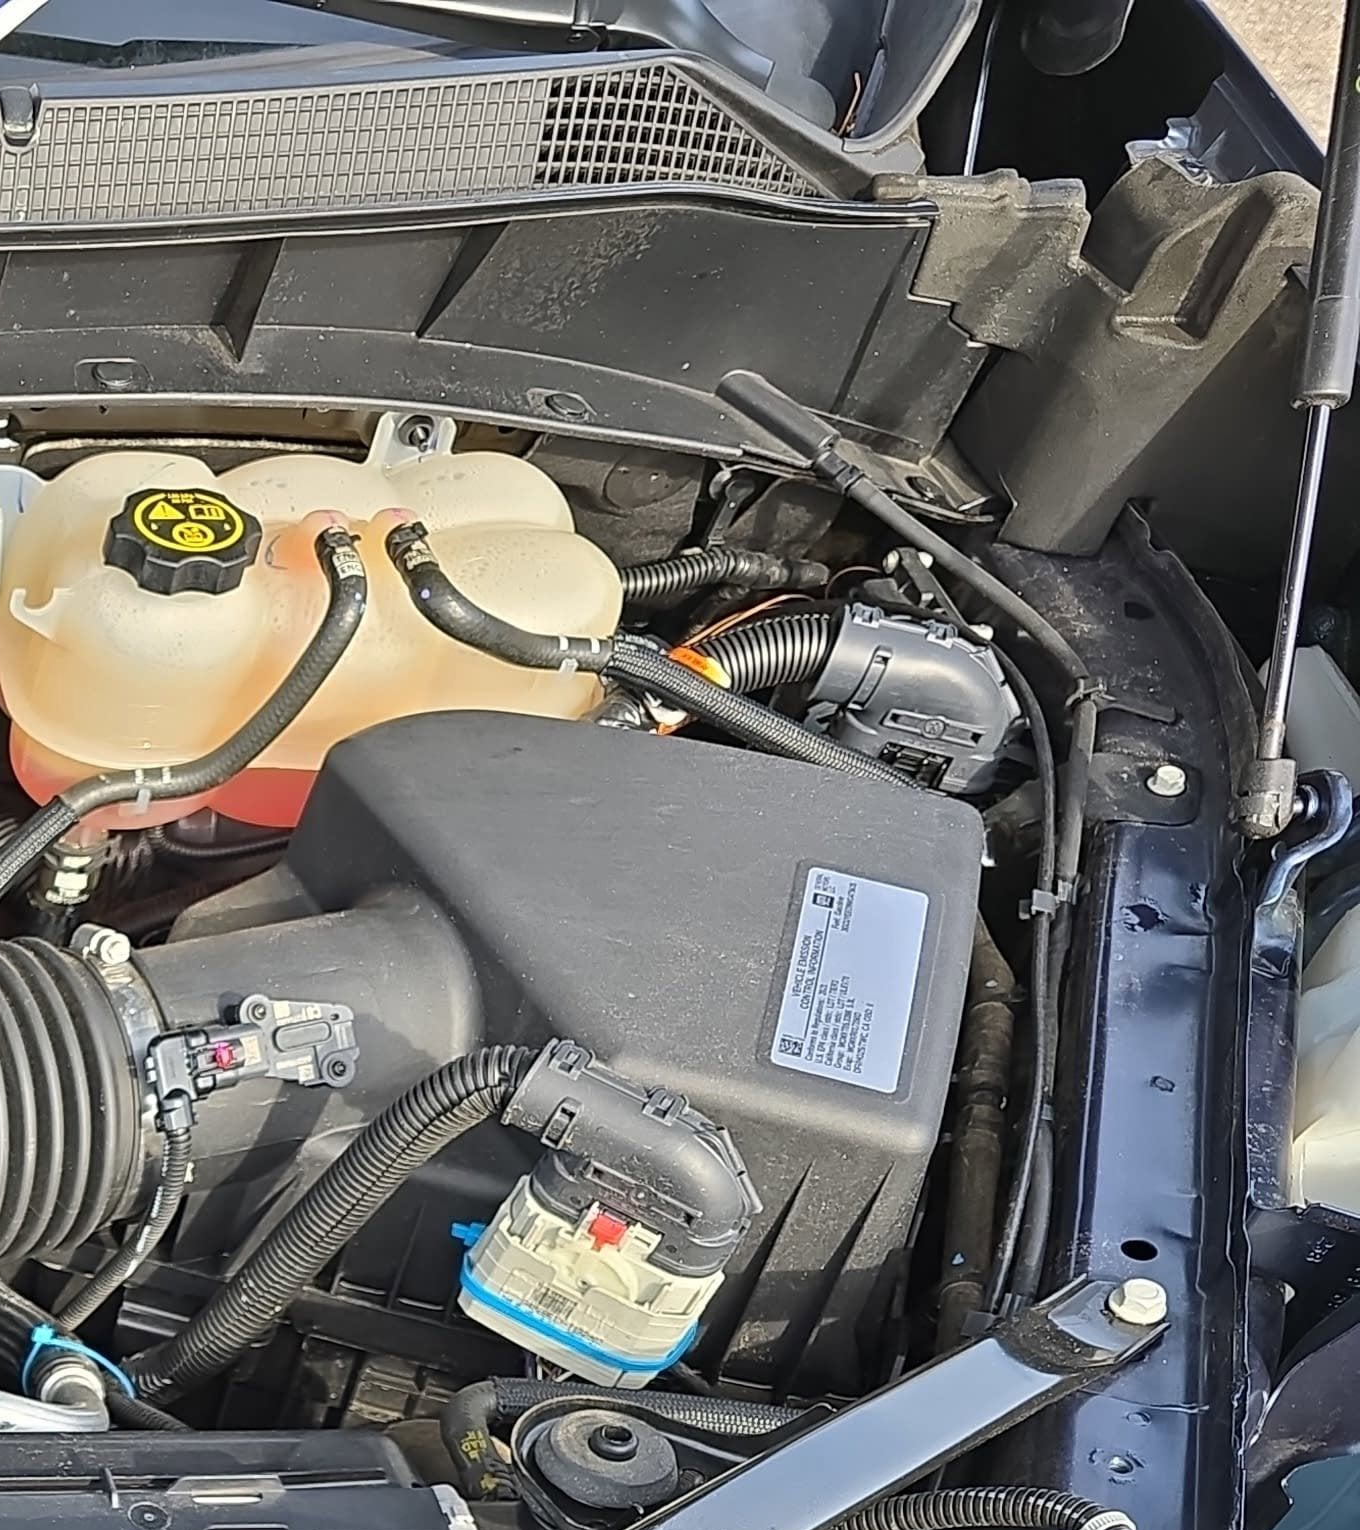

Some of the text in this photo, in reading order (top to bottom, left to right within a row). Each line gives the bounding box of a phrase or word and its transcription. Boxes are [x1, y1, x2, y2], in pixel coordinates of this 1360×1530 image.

[790, 934, 812, 997] VEHICLE EMISSION
[799, 929, 824, 1010] CONTROL INFORMATION
